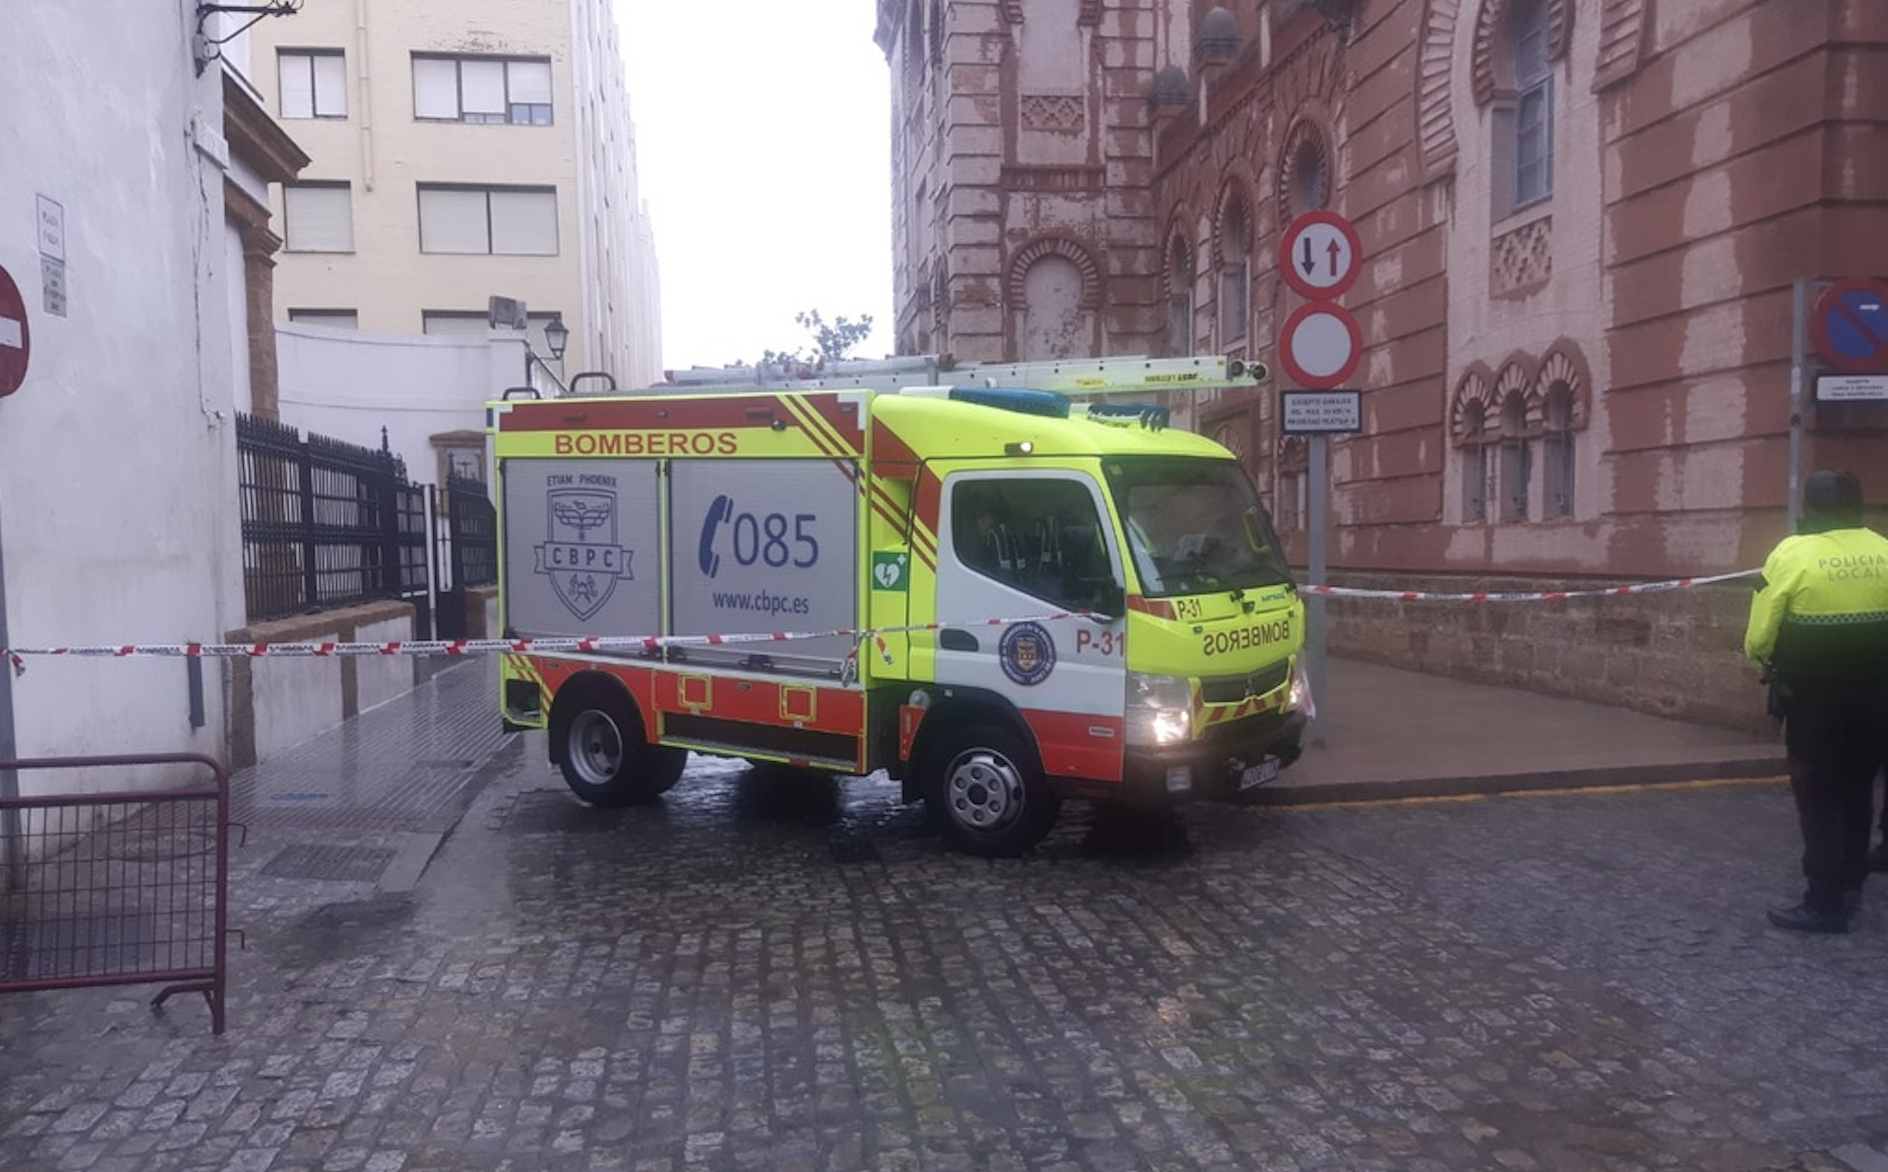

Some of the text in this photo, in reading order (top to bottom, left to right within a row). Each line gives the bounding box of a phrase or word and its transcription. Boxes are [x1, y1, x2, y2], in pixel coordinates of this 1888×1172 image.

[554, 432, 738, 455] BOMBEROS
[547, 474, 617, 487] ETIAM PHOENIX
[733, 512, 819, 568] 085
[1818, 555, 1886, 569] POLICIA
[1828, 567, 1881, 581] LOCAL
[712, 589, 809, 617] www.cbpc.es
[1177, 599, 1202, 619] P-31
[1077, 629, 1124, 657] P-31
